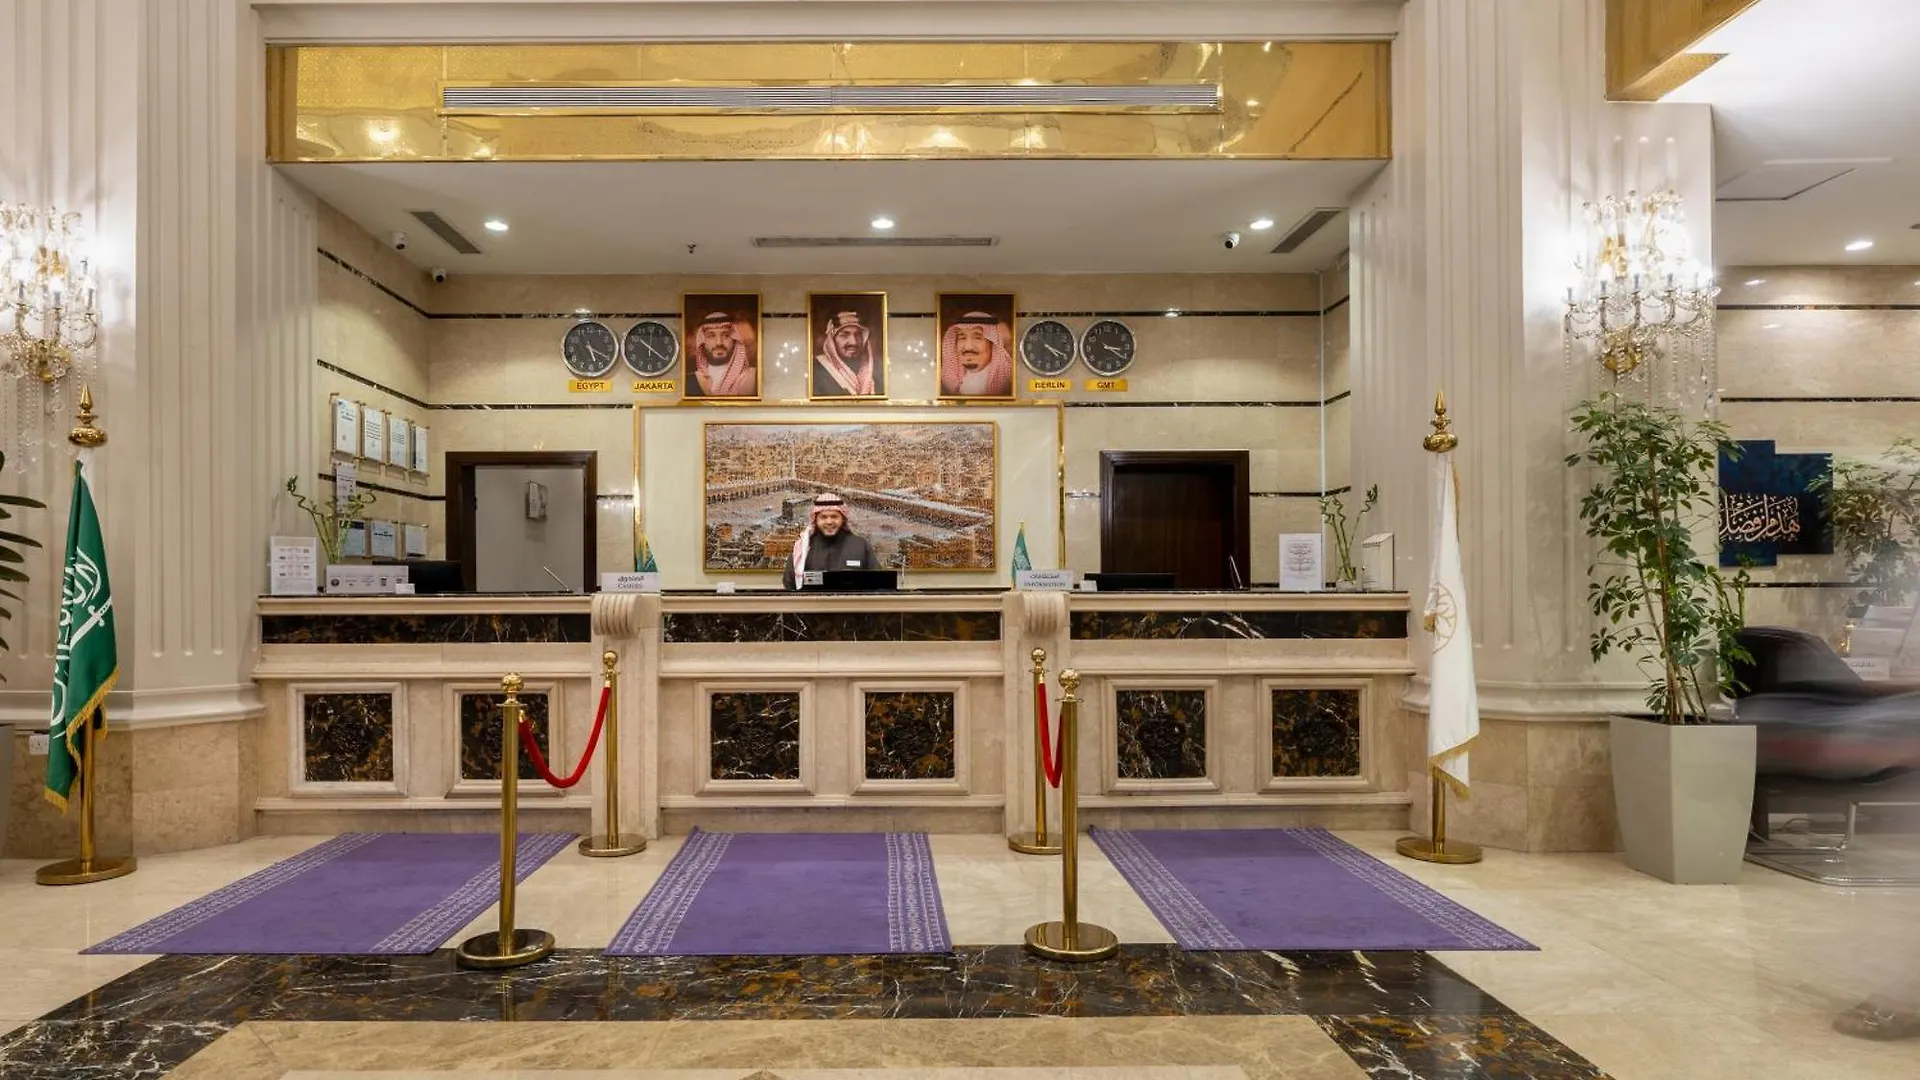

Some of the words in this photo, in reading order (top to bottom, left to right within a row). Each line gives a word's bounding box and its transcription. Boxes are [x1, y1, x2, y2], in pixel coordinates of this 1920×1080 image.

[576, 382, 605, 390] EGYPT
[634, 382, 674, 390] JAKARTA
[1035, 381, 1065, 389] BERLIN
[1097, 381, 1115, 389] GMT
